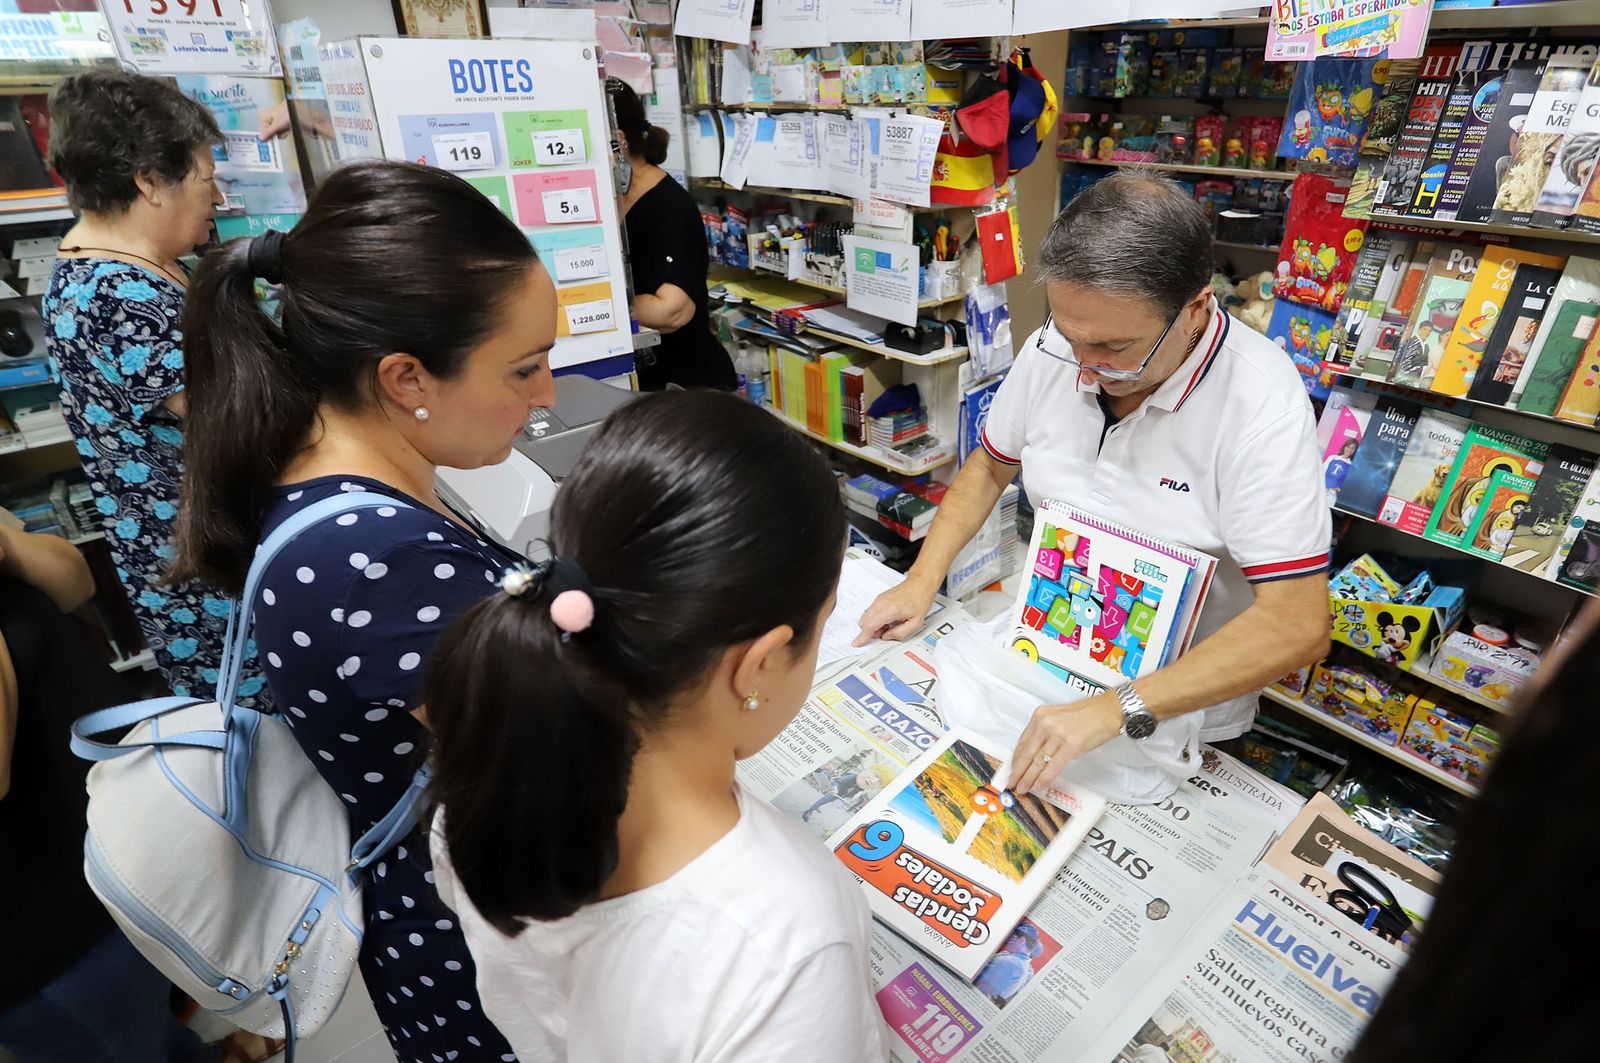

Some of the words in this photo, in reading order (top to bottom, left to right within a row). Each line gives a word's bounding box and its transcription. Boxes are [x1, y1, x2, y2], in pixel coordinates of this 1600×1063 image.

[1308, 8, 1344, 27] ESTABA
[448, 58, 534, 94] BOTES
[886, 126, 913, 139] 53887
[449, 146, 482, 161] 119
[546, 142, 574, 156] 12,3
[560, 201, 579, 214] 5,8
[1414, 182, 1441, 208] H
[1372, 222, 1446, 236] HISTORIA
[570, 259, 594, 269] 15.000
[1526, 282, 1540, 293] LA
[572, 313, 610, 325] 1.228.000
[1385, 406, 1406, 423] Una
[1377, 422, 1410, 439] para
[1428, 431, 1451, 444] todo
[1477, 427, 1533, 448] EVANGELIO
[1560, 461, 1569, 469] EL
[1159, 477, 1190, 493] FILA
[1039, 551, 1055, 566] 13
[796, 711, 826, 736] spende
[802, 703, 823, 720] Boris
[819, 716, 853, 744] Johnson
[858, 692, 884, 716] LA
[881, 710, 934, 749] RAZO
[783, 725, 806, 745] celera
[805, 743, 816, 754] un
[790, 718, 834, 754] Parlamento
[787, 741, 815, 765] salvaje
[1216, 766, 1284, 812] ILUSTRADA
[1110, 802, 1140, 824] Brexit
[1140, 821, 1164, 840] duro
[1130, 804, 1181, 840] Parlamento
[848, 820, 904, 861] 6
[1082, 827, 1154, 881] PAÍS
[896, 852, 986, 917] Sociales
[1079, 890, 1105, 911] duro
[894, 886, 990, 945] Ciencias
[923, 925, 954, 948] ANAYA
[1234, 900, 1381, 1016] Huelva
[911, 968, 933, 991] MAÑANA
[932, 990, 976, 1032] EUROMILLONES
[1193, 961, 1220, 988] sin
[1222, 984, 1284, 1039] nuevos
[1205, 947, 1259, 992] Salud
[1262, 985, 1327, 1047] registra
[912, 1002, 965, 1054] 119
[901, 1024, 933, 1060] MILLONES
